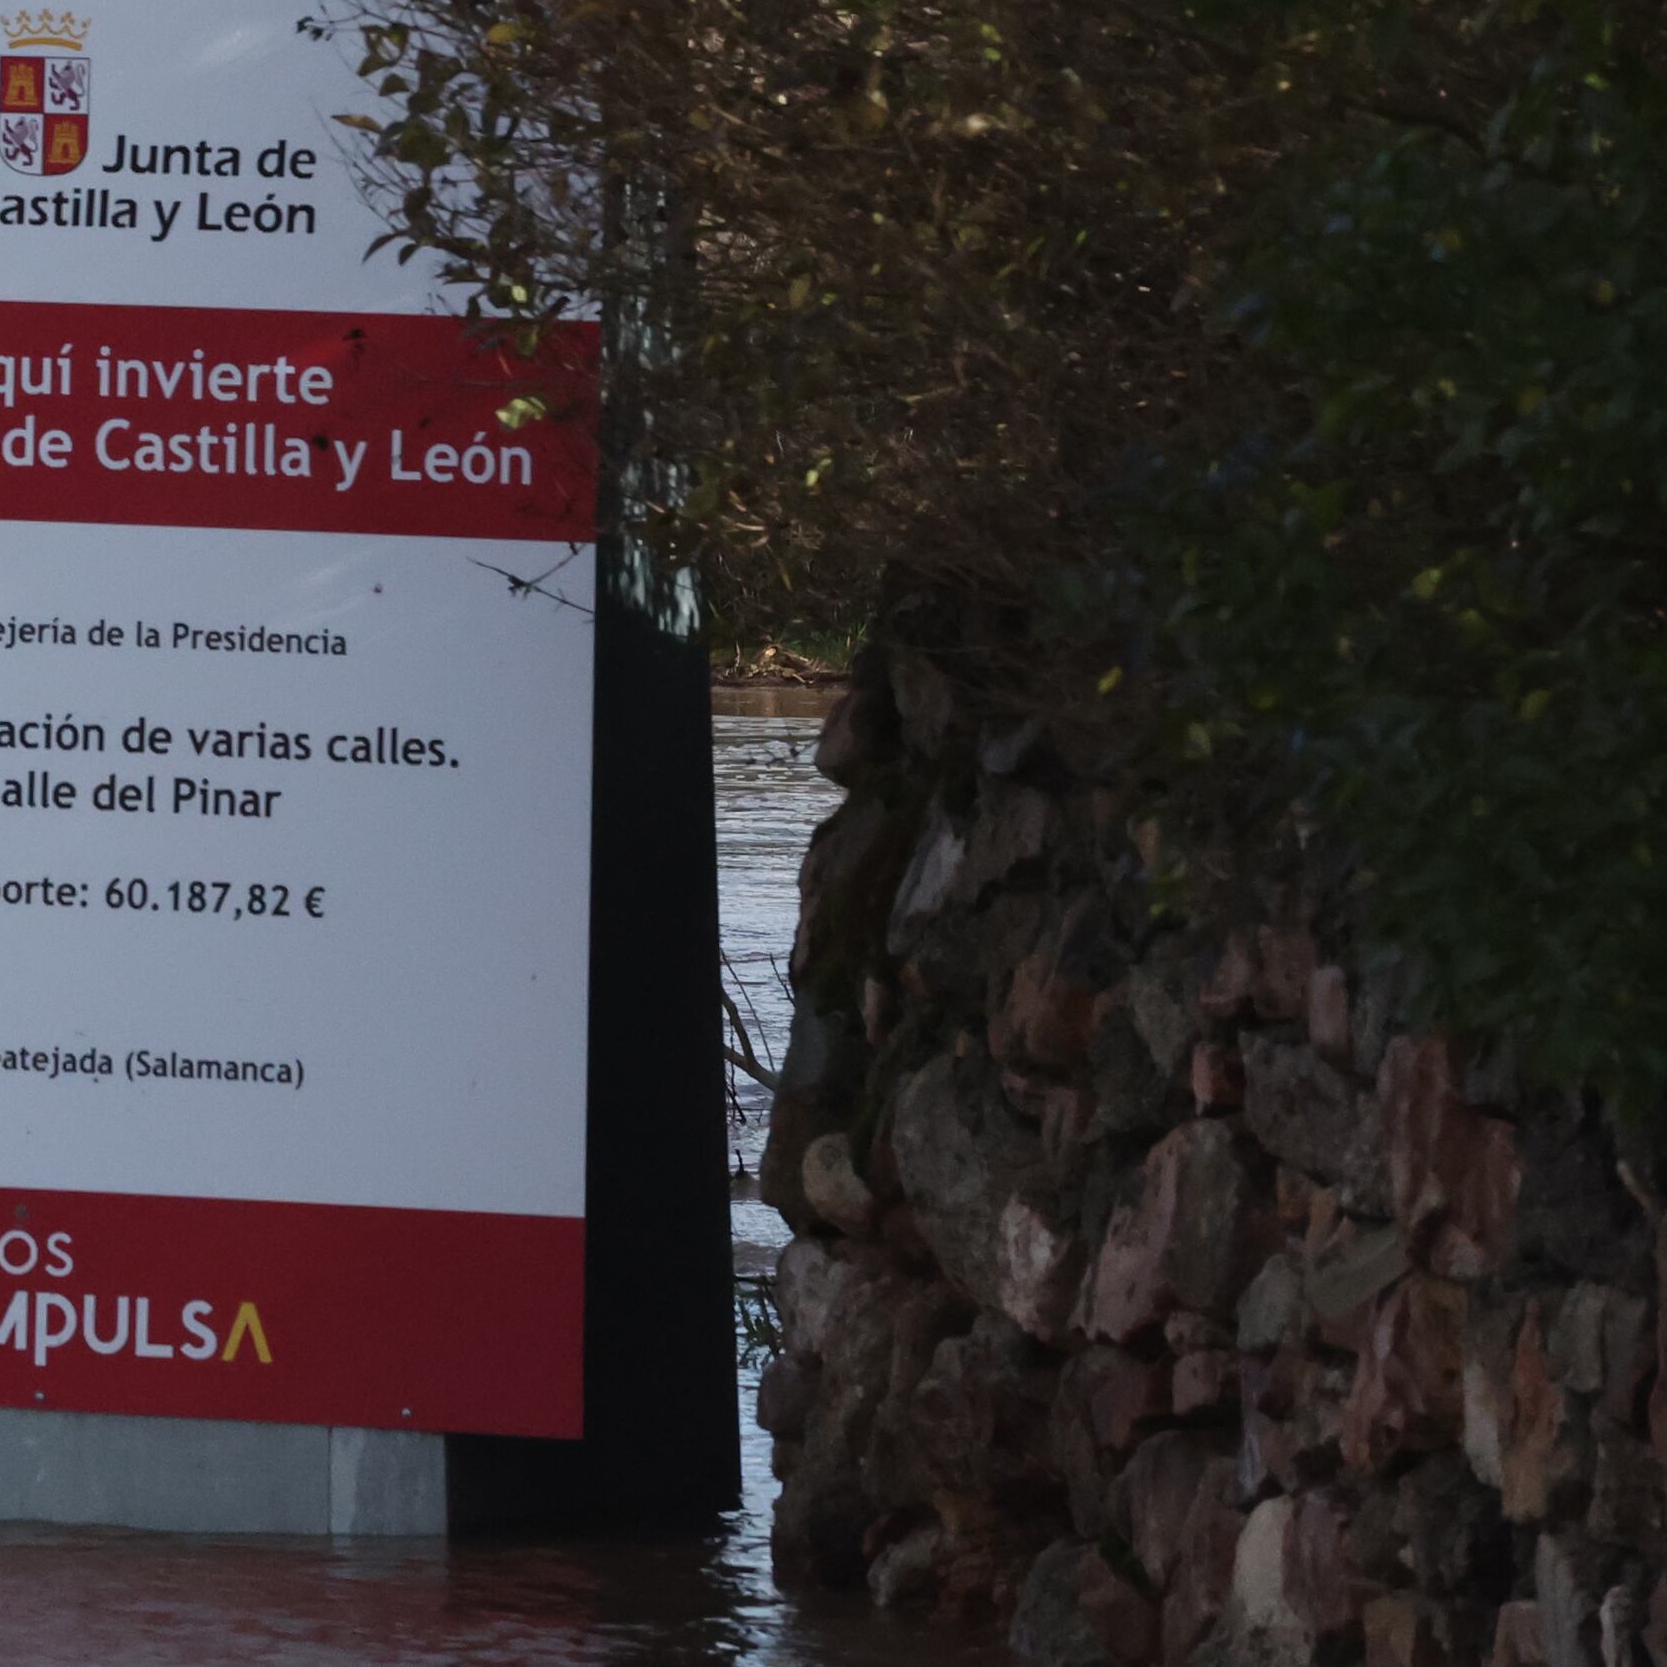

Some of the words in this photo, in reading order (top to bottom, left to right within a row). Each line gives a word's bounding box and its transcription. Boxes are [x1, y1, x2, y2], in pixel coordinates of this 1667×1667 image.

[102, 134, 241, 176] Junta
[256, 140, 316, 179] de
[151, 200, 181, 242] y
[198, 192, 315, 234] León
[96, 345, 334, 406] invierte
[1, 414, 73, 468] de
[95, 417, 311, 477] Castilla
[334, 440, 367, 493] y
[390, 428, 532, 486] León
[87, 619, 124, 647] de
[136, 621, 161, 649] la
[172, 623, 347, 656] Presidencia
[121, 716, 173, 755] de
[186, 722, 312, 761] varias
[326, 726, 460, 769] calles.
[92, 773, 155, 813] del
[173, 777, 282, 818] Pinar
[104, 877, 291, 921] 60.187,82
[304, 886, 326, 918] €
[125, 1050, 306, 1090] (Salamanca)
